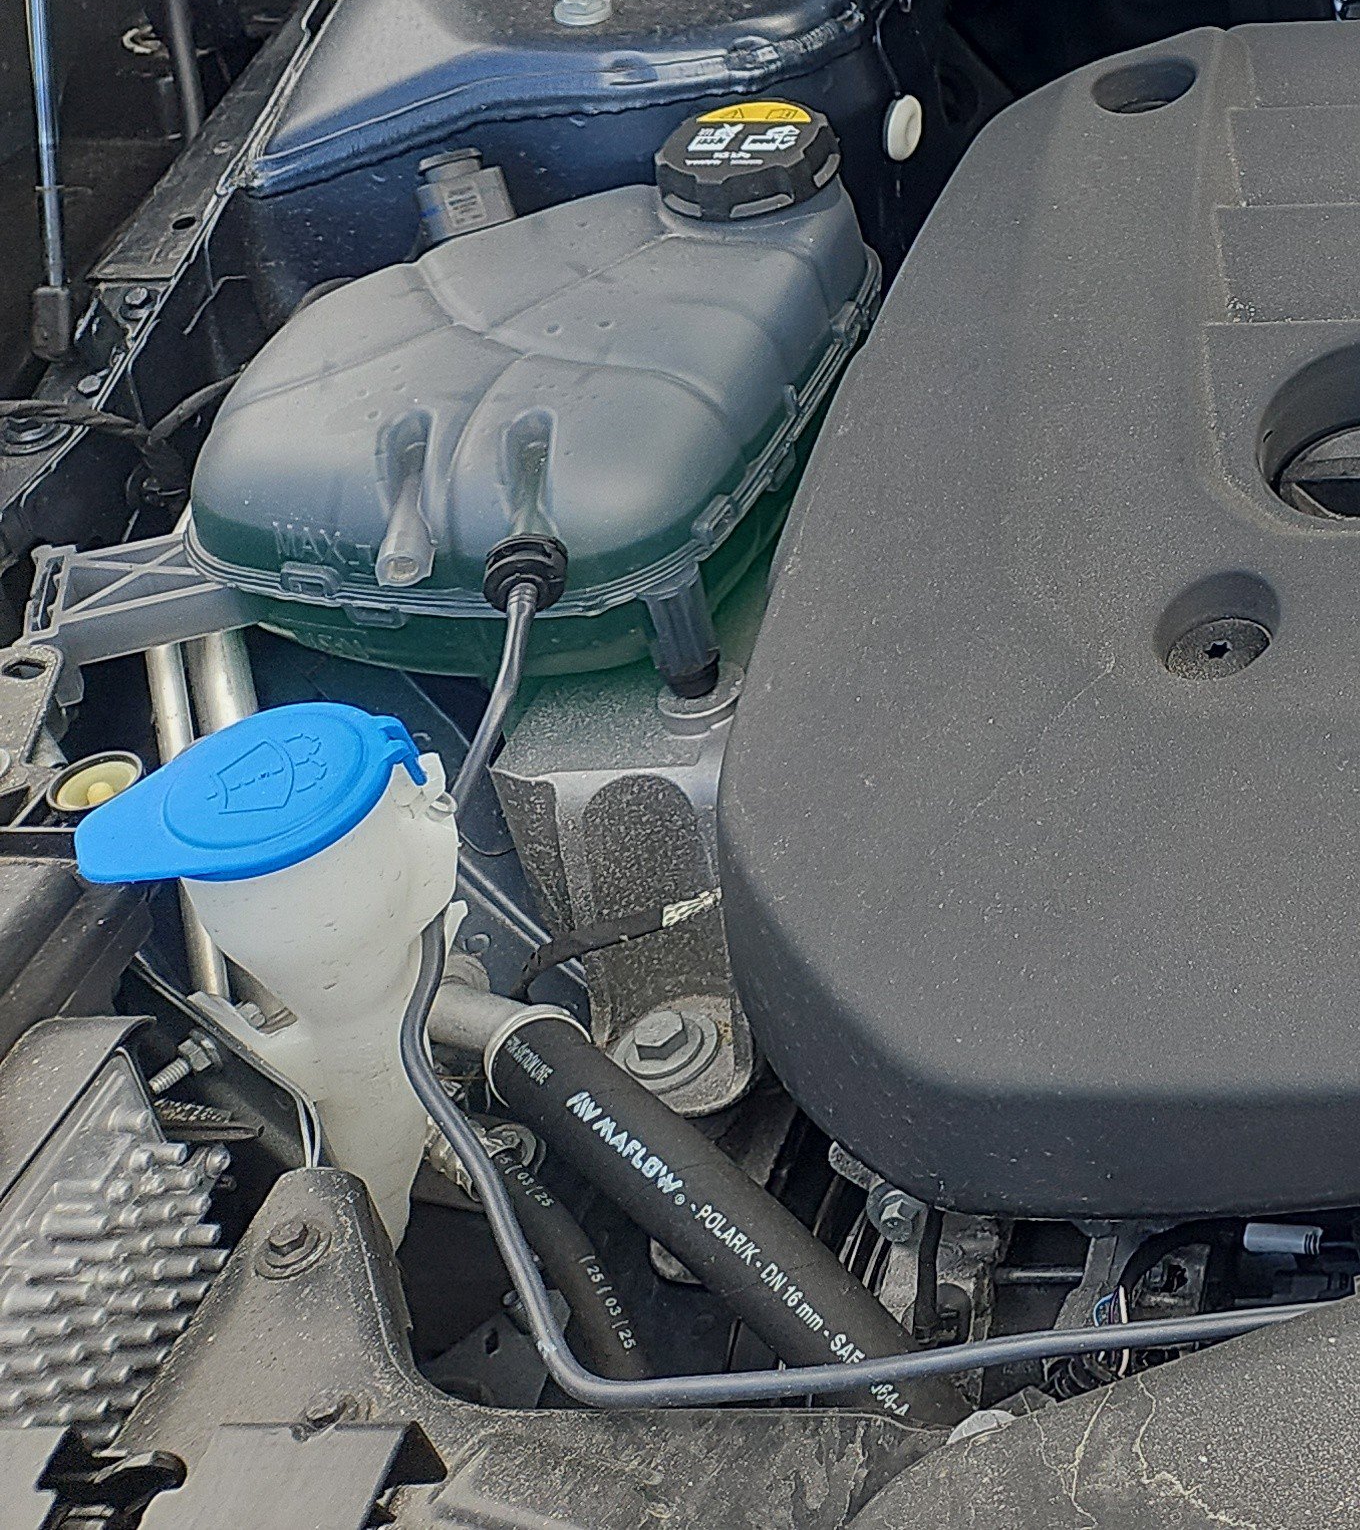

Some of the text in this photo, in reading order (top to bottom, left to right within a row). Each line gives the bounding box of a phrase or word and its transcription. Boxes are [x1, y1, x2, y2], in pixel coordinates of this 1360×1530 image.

[272, 520, 347, 564] MAX
[760, 1262, 788, 1292] DN
[783, 1285, 803, 1307] 16
[795, 1302, 824, 1331] mm
